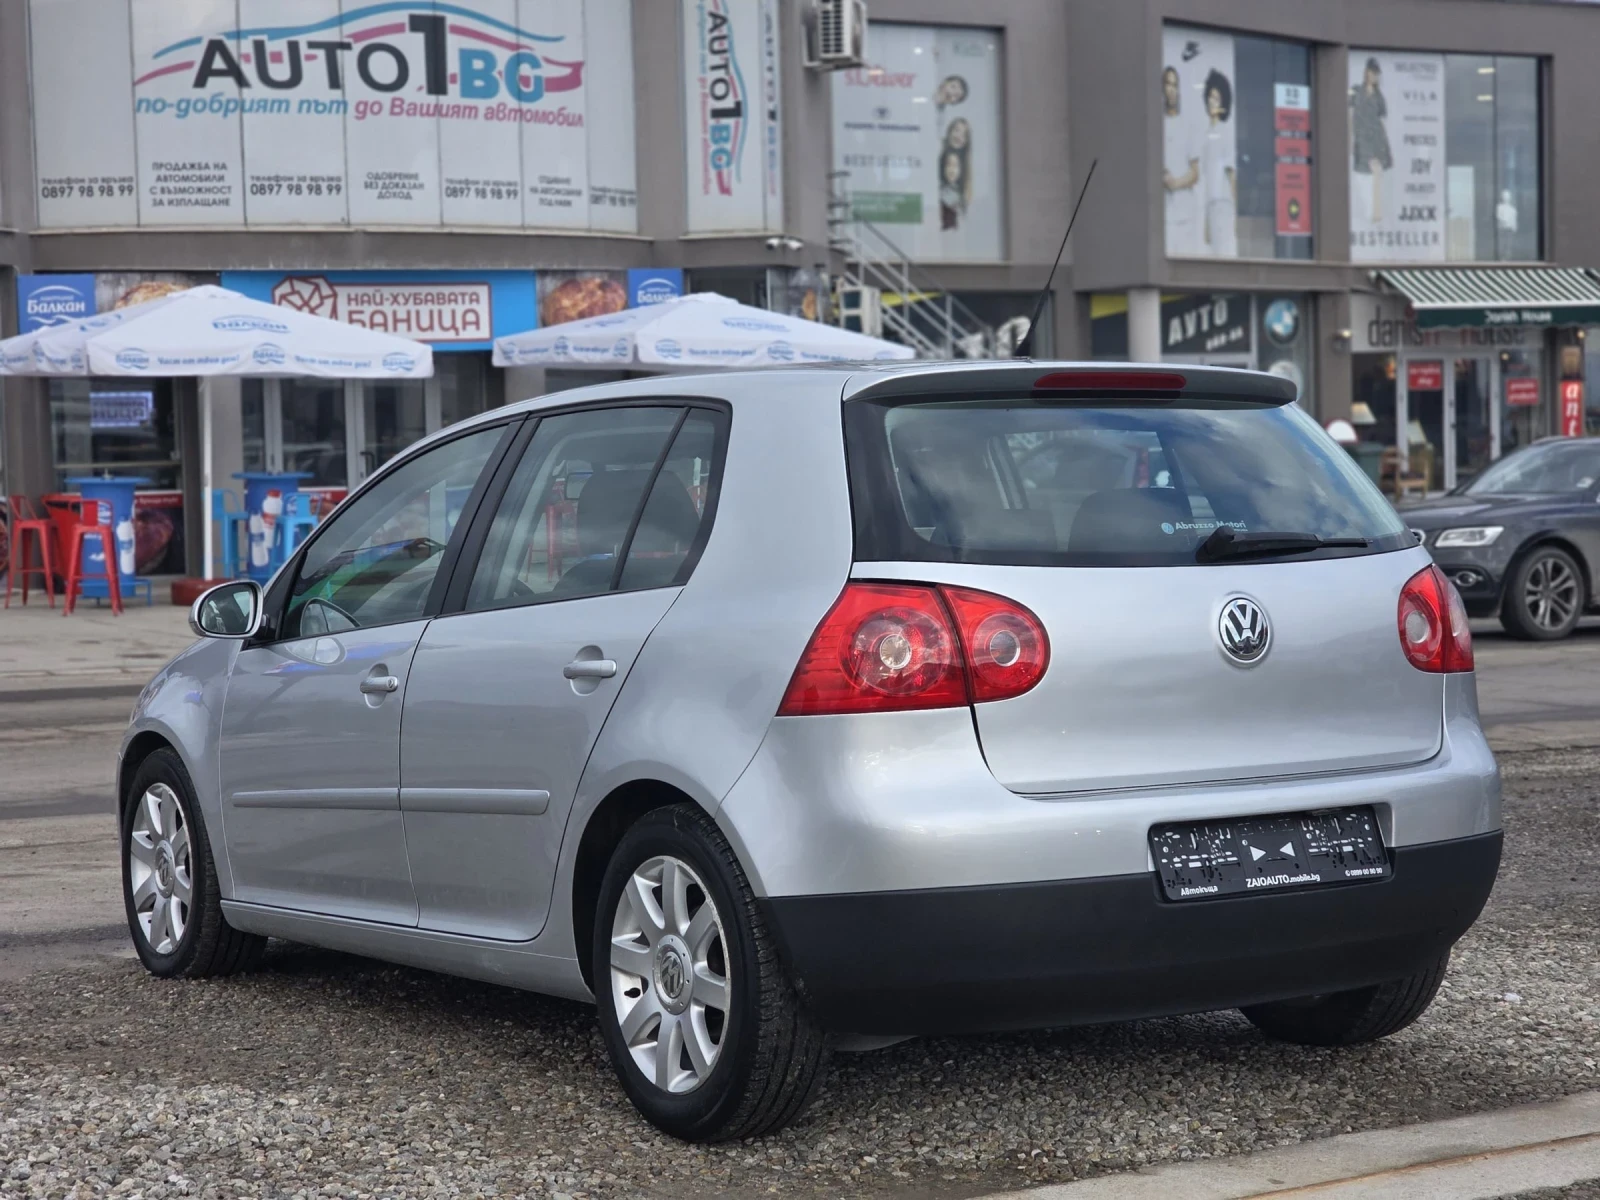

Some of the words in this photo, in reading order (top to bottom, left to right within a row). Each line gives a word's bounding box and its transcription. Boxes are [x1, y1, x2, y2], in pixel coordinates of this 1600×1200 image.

[135, 92, 290, 119] по-добрият
[297, 97, 349, 115] път
[354, 99, 383, 121] до
[389, 98, 479, 121] Вашият
[484, 102, 584, 128] автомобил
[151, 162, 211, 172] ПРОДАЖБА
[212, 162, 228, 172] НА
[155, 173, 225, 183] АВТОМОБИЛИ
[41, 185, 73, 199] 0897
[78, 185, 94, 198] 98
[98, 185, 114, 198] 98
[118, 184, 134, 197] 99
[149, 185, 158, 195] С
[160, 185, 232, 195] ВЪЗМОЖНОСТ
[250, 183, 282, 196] 0897
[287, 183, 302, 196] 98
[306, 183, 323, 196] 98
[327, 183, 342, 196] 99
[445, 186, 471, 199] 0897
[474, 187, 487, 199] 98
[491, 187, 503, 200] 98
[506, 188, 519, 200] 99
[151, 197, 165, 207] ЗА
[167, 197, 231, 207] ИЗПЛАЩАНЕ
[346, 289, 481, 306] НАЙ-ХУБАВАТА
[27, 299, 86, 314] Балкан
[348, 308, 481, 336] БАНИЦА
[1175, 521, 1215, 530] Abruzzo
[1180, 884, 1219, 897] Автокъща
